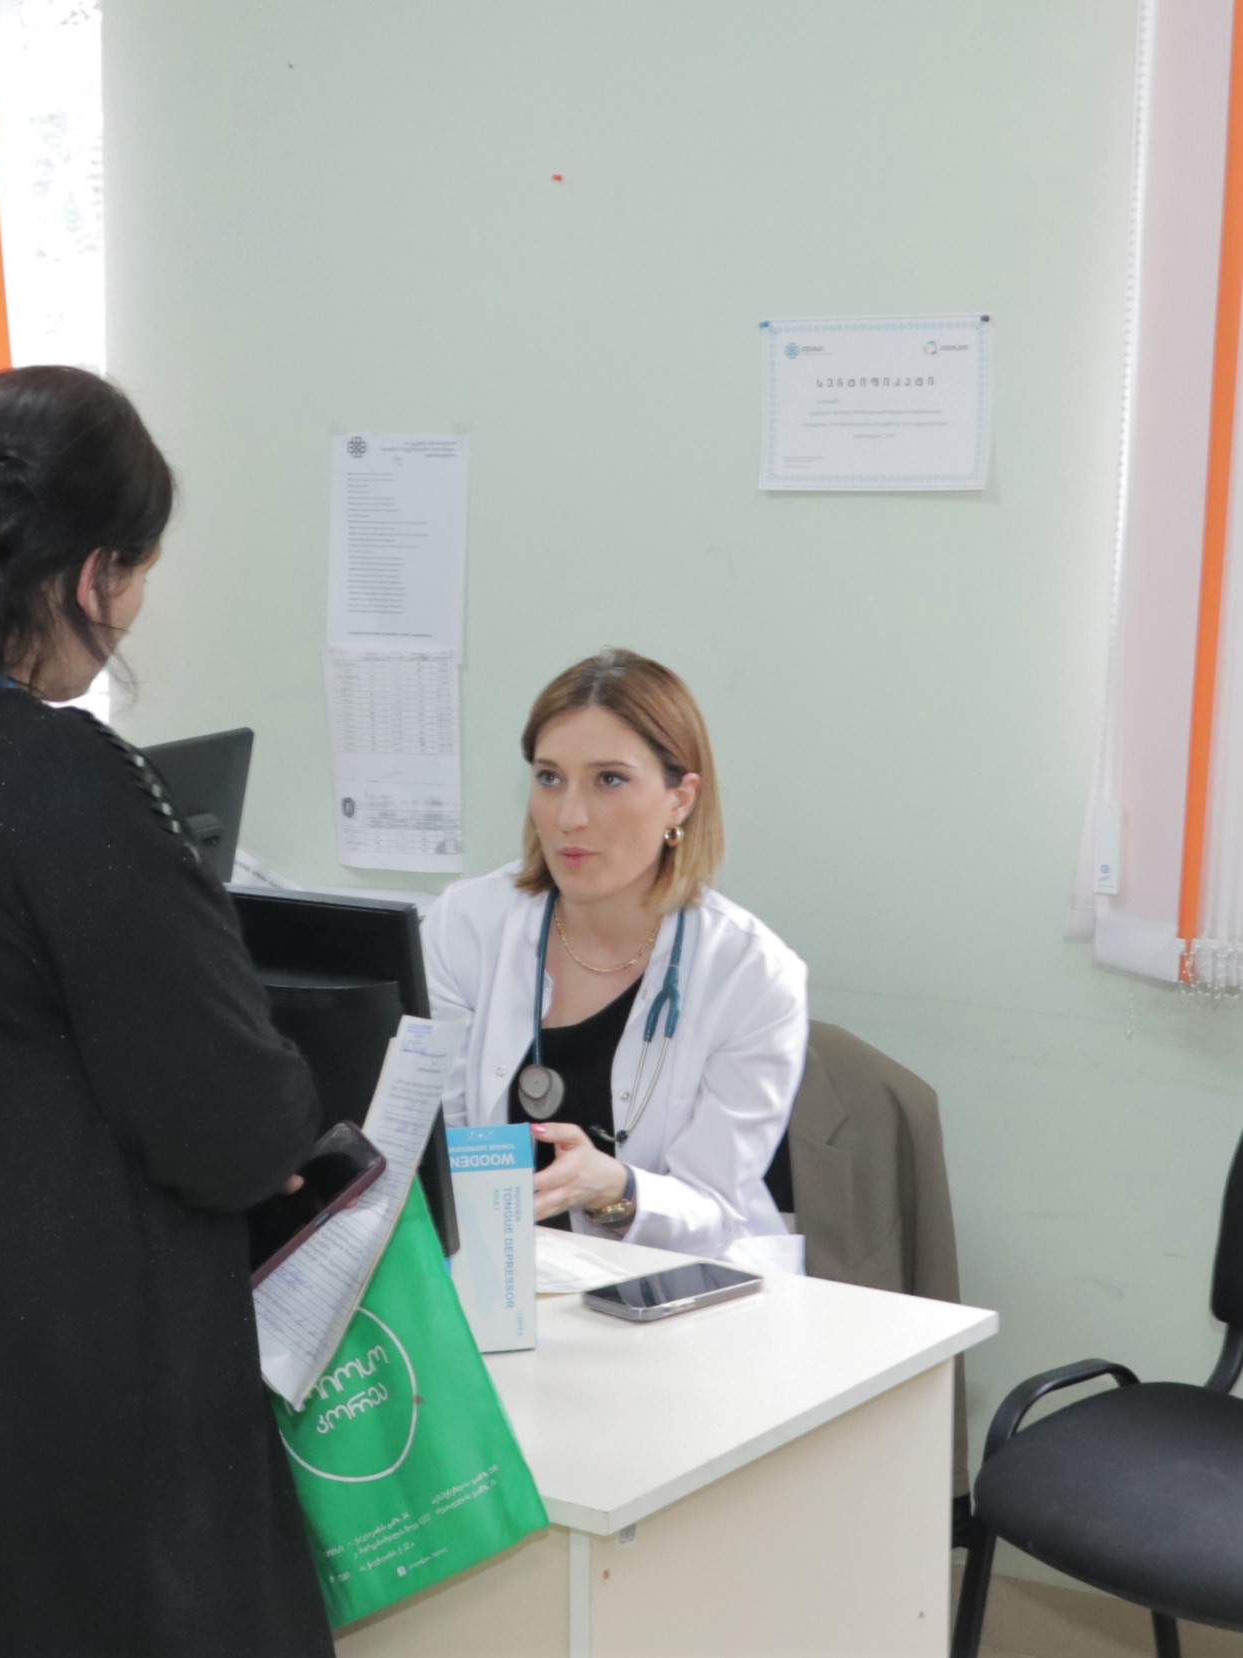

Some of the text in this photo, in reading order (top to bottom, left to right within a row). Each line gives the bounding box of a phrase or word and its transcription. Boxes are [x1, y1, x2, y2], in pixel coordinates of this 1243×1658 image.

[450, 1152, 515, 1168] WOODEN
[503, 1186, 514, 1309] TONGUE DEPRESSOR
